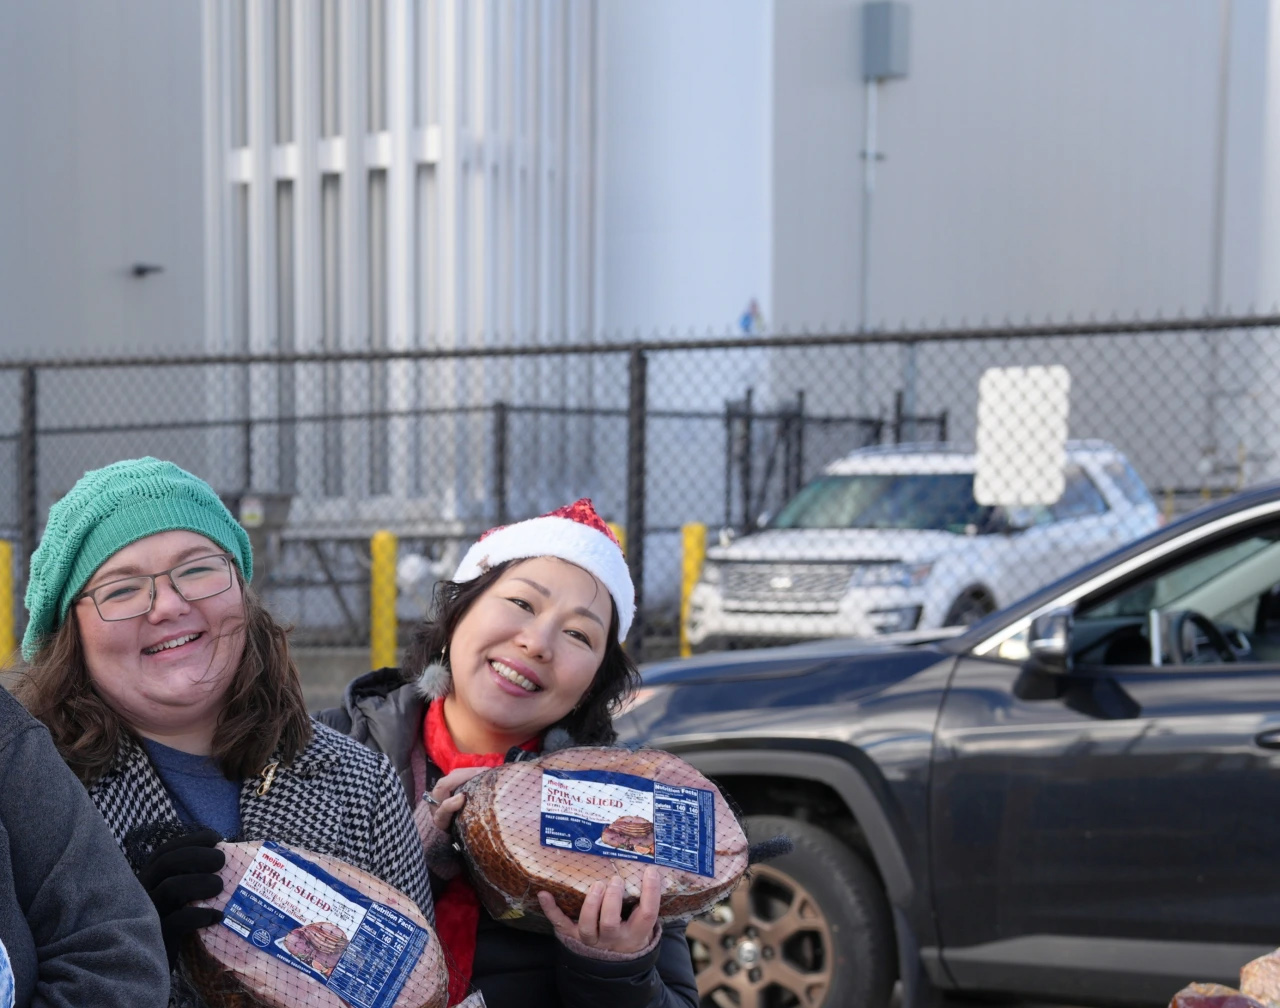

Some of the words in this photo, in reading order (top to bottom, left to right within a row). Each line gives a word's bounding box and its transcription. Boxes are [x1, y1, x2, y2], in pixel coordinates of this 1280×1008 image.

[547, 788, 583, 803] SPIRAL
[586, 797, 623, 808] SLICED
[655, 784, 680, 793] Nutrition
[681, 788, 698, 796] Facts
[547, 794, 572, 806] HAM
[262, 853, 285, 870] meijer
[251, 869, 278, 890] HAM
[256, 861, 294, 889] SPIRAL
[294, 885, 331, 912] SLICED
[372, 902, 398, 922] Nutrition
[397, 917, 414, 932] Facts
[381, 934, 392, 944] 140
